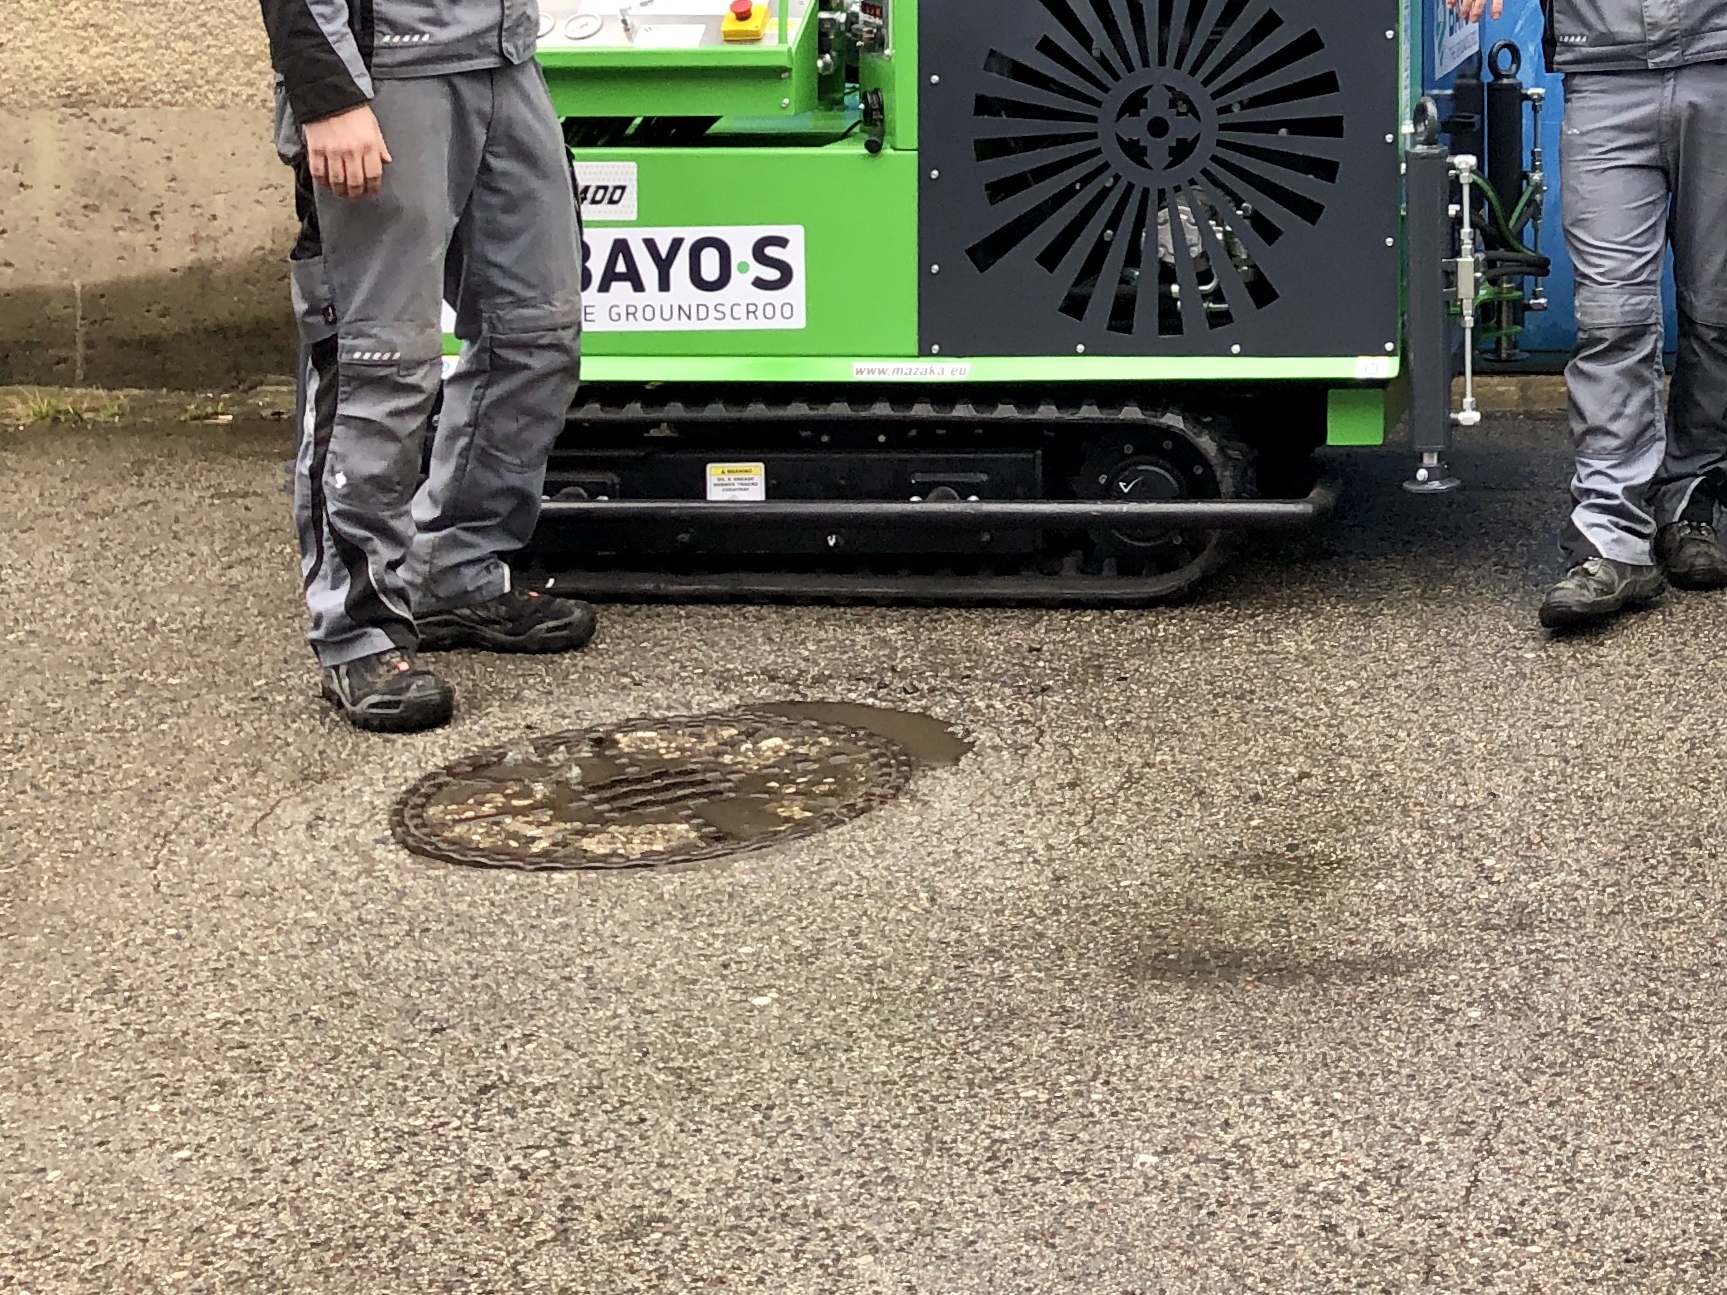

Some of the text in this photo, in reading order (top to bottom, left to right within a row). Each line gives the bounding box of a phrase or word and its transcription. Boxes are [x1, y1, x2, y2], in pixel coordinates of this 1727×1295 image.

[580, 185, 627, 206] 400
[608, 302, 794, 323] GROUNDSCROO
[855, 365, 967, 377] www.mazakaeu
